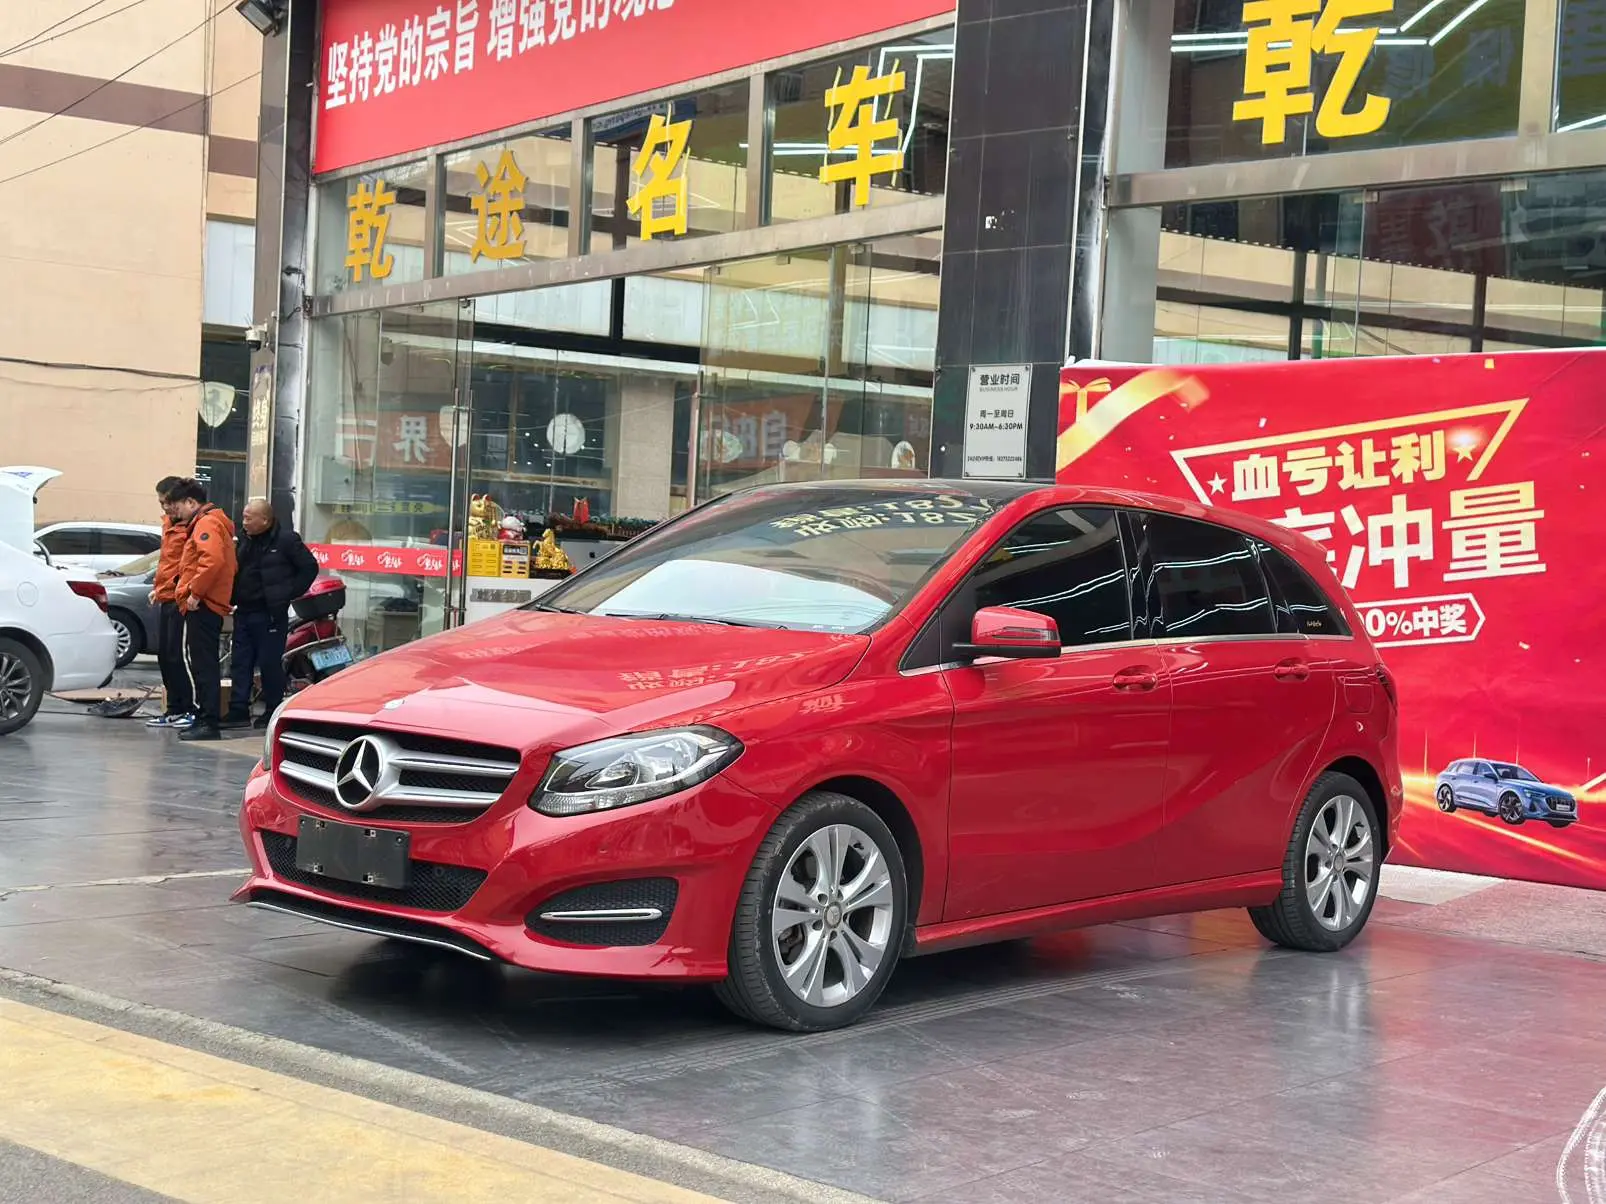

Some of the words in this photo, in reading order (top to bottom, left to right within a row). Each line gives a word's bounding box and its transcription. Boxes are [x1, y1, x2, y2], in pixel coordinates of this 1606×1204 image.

[325, 0, 480, 109] 坚持党的宗旨
[344, 61, 906, 283] 乾途名车
[979, 373, 1020, 386] 营业时间
[980, 409, 1014, 418] 周一至周日
[1231, 428, 1446, 502] 血亏让利
[1358, 603, 1467, 637] 0%中奖
